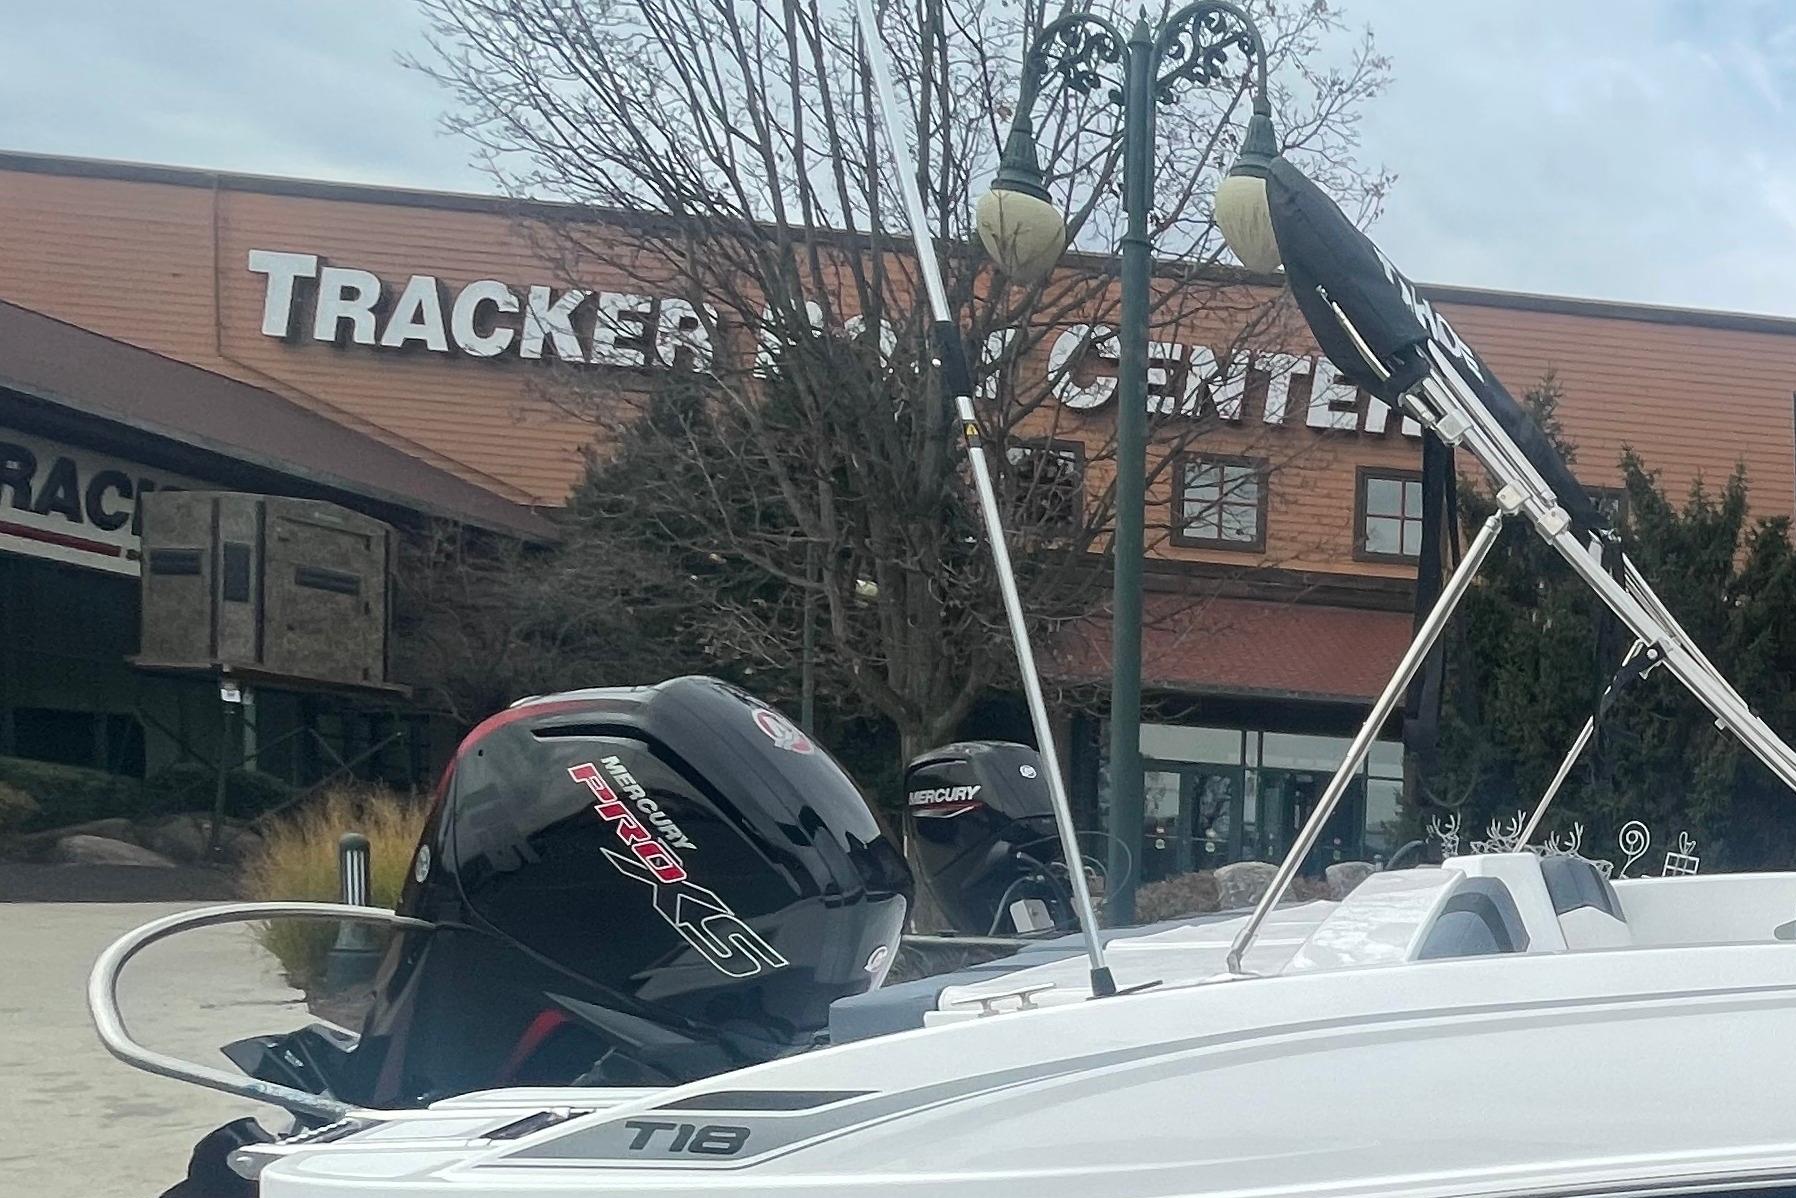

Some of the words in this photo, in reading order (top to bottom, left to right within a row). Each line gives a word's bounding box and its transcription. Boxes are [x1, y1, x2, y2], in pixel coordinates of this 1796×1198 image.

[248, 249, 718, 373] TRACKER
[567, 762, 688, 884] PRO
[600, 755, 698, 850] MERCURY
[908, 785, 982, 806] MERCURY
[599, 840, 790, 978] XS
[625, 1120, 750, 1155] T18
